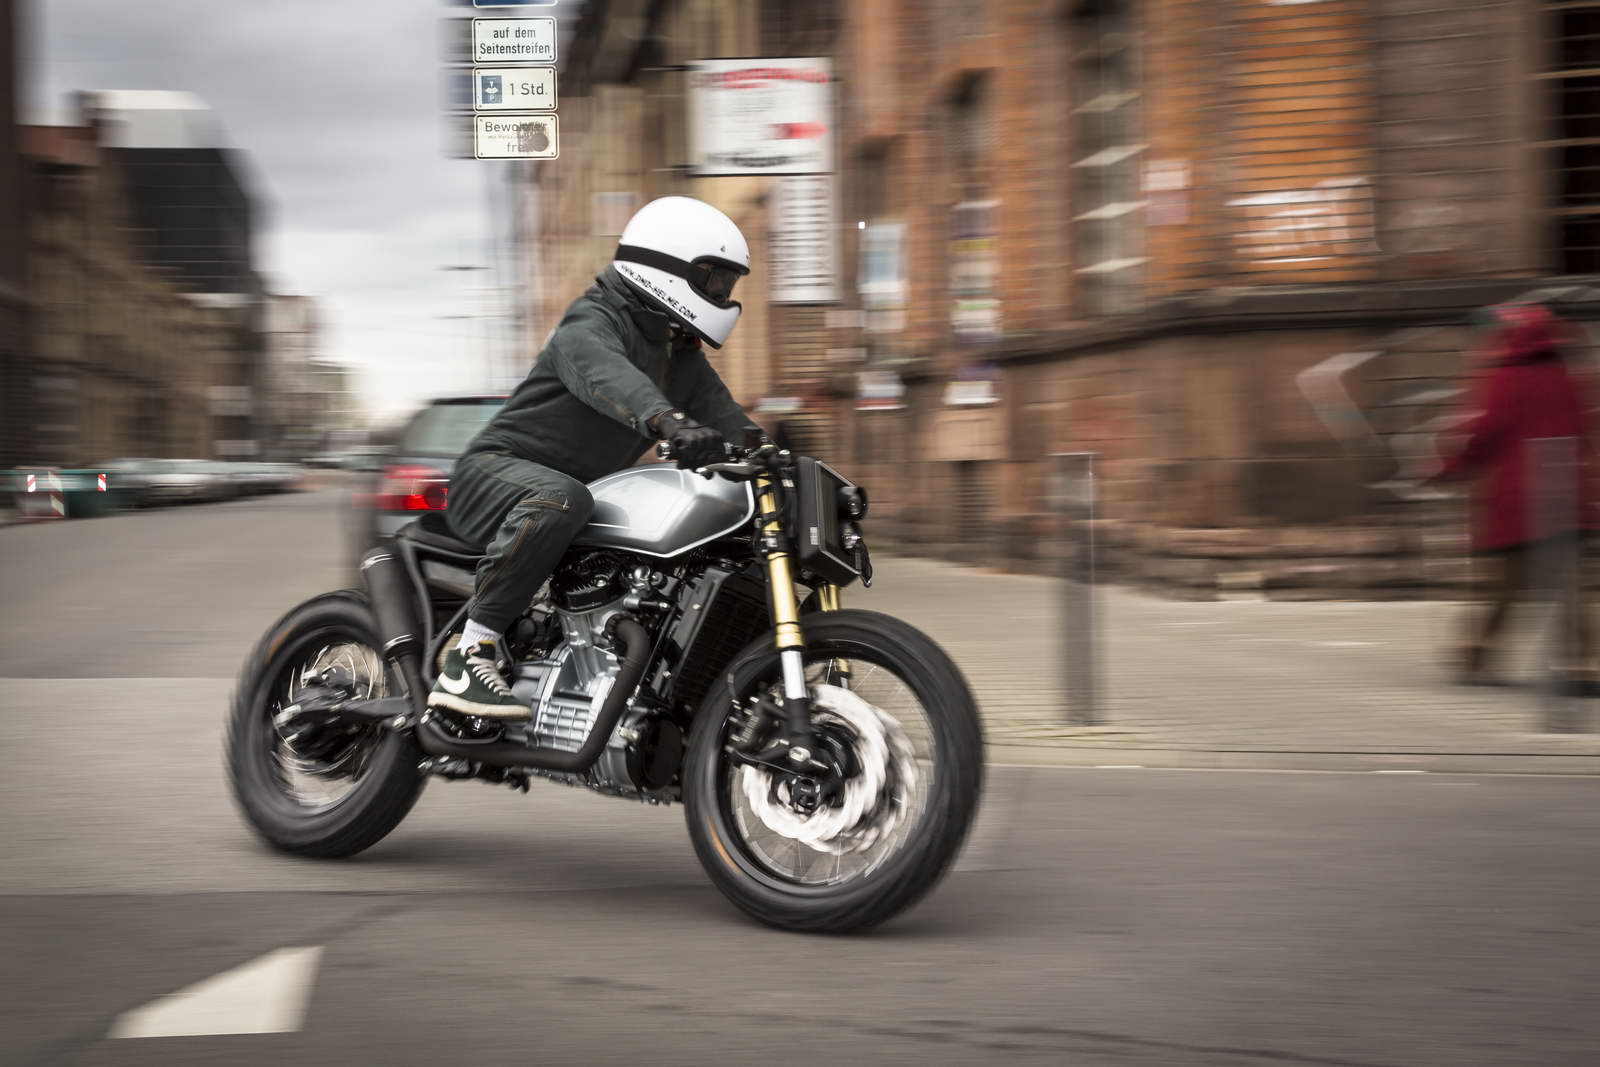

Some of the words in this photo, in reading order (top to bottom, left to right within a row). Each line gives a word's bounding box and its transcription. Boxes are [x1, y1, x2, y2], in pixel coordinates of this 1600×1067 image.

[493, 27, 510, 38] auf
[515, 26, 536, 38] dem
[480, 43, 550, 54] Seitenstreifen
[509, 83, 514, 95] 1
[521, 83, 548, 96] Std.
